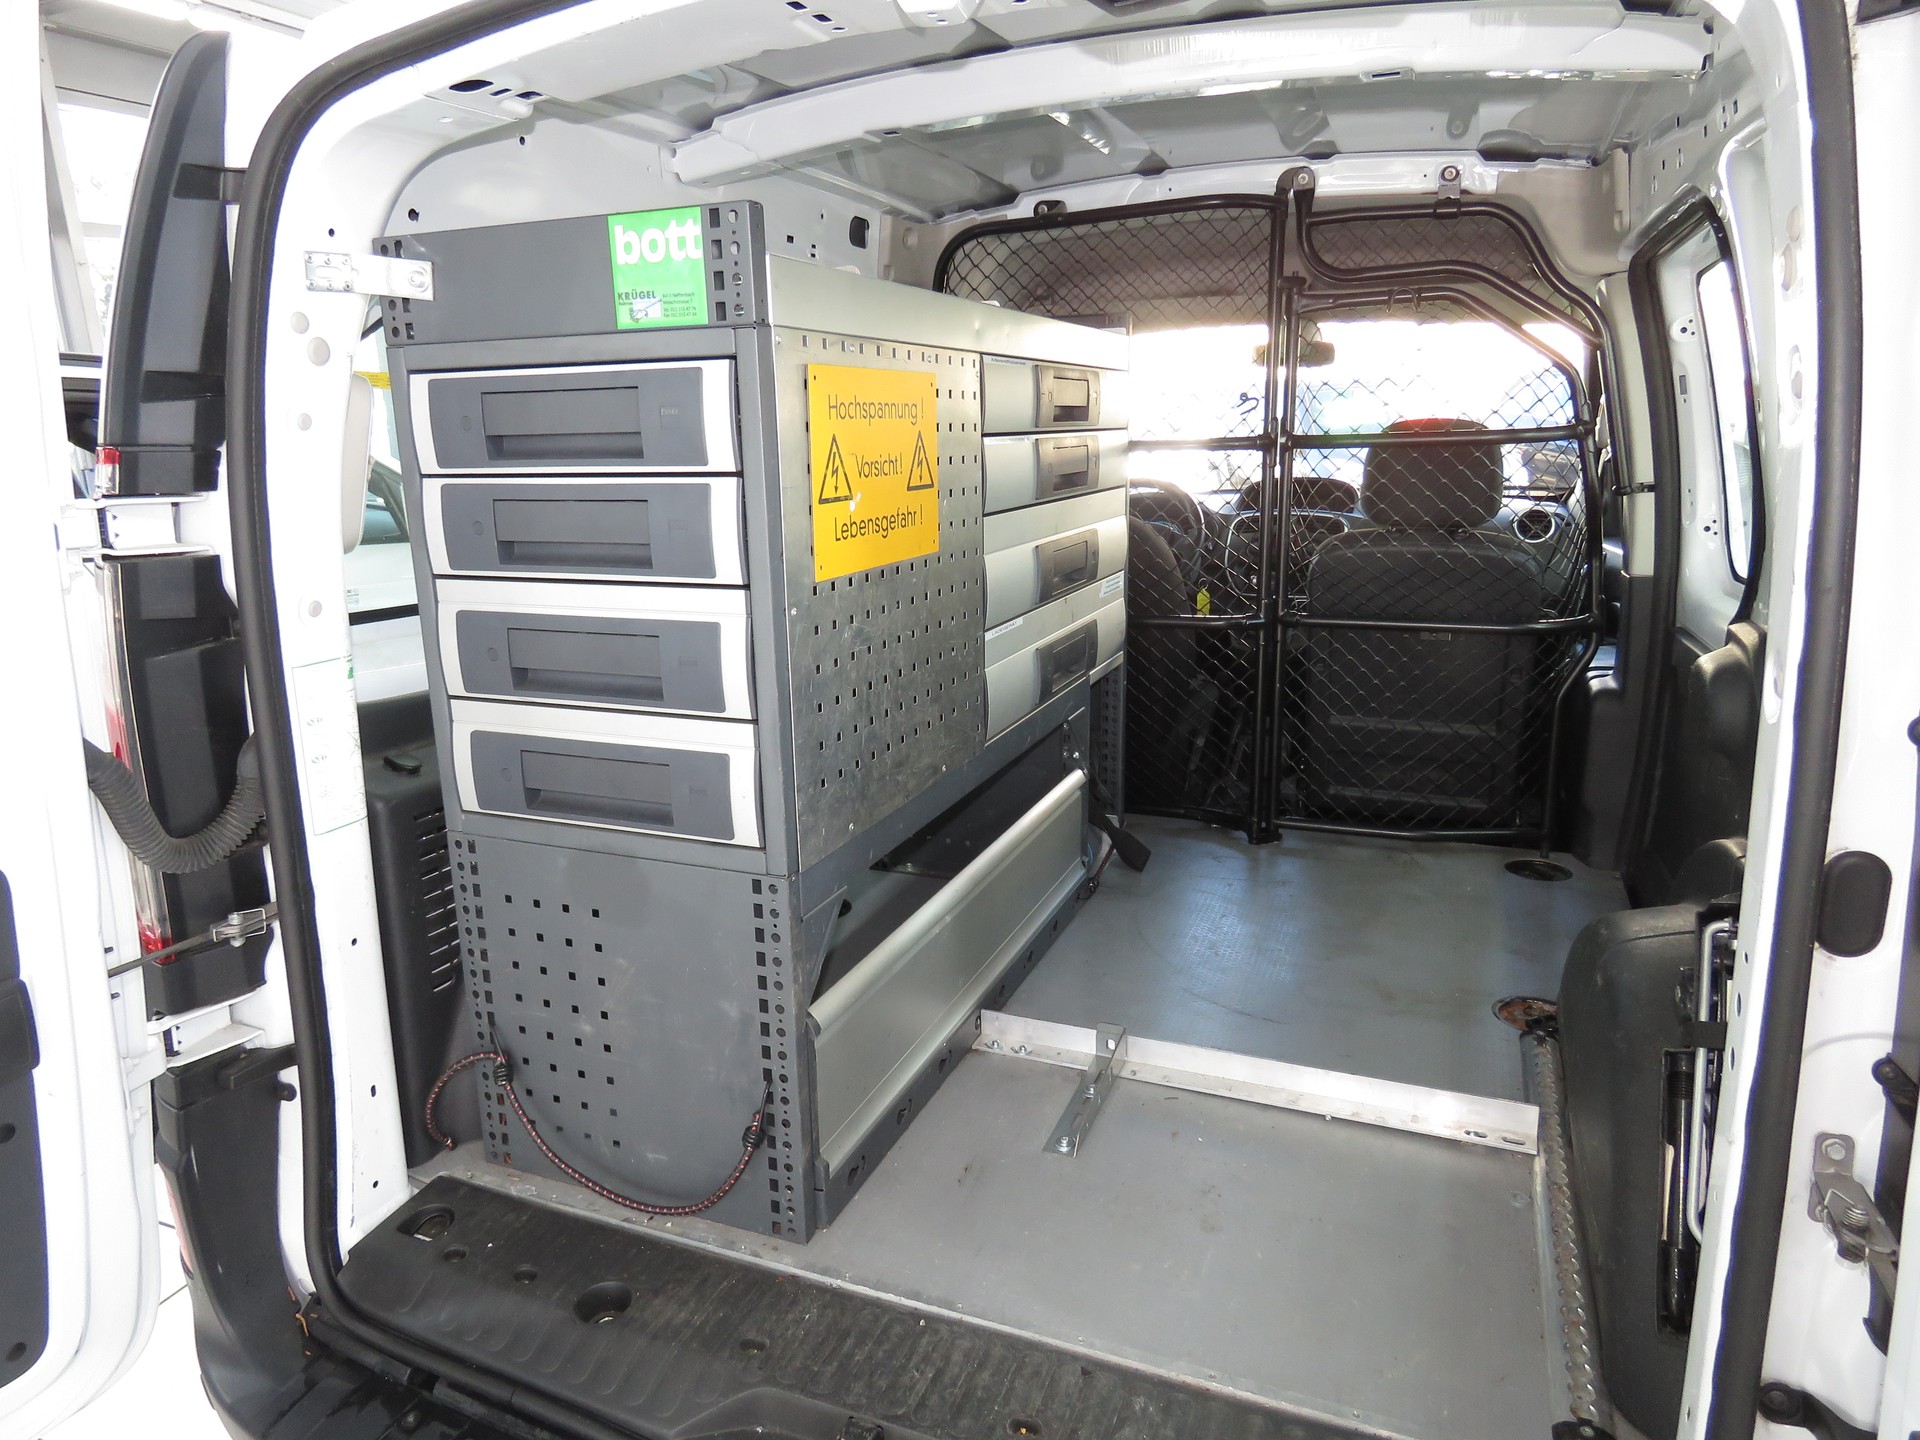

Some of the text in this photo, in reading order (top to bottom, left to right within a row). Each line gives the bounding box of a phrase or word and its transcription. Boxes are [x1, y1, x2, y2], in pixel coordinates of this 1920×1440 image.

[614, 218, 703, 265] bott
[617, 288, 657, 301] KRÜGEL
[828, 394, 918, 426] Hochspannung
[855, 452, 903, 479] Vorsicht!
[834, 505, 917, 542] Lebensgefahr
